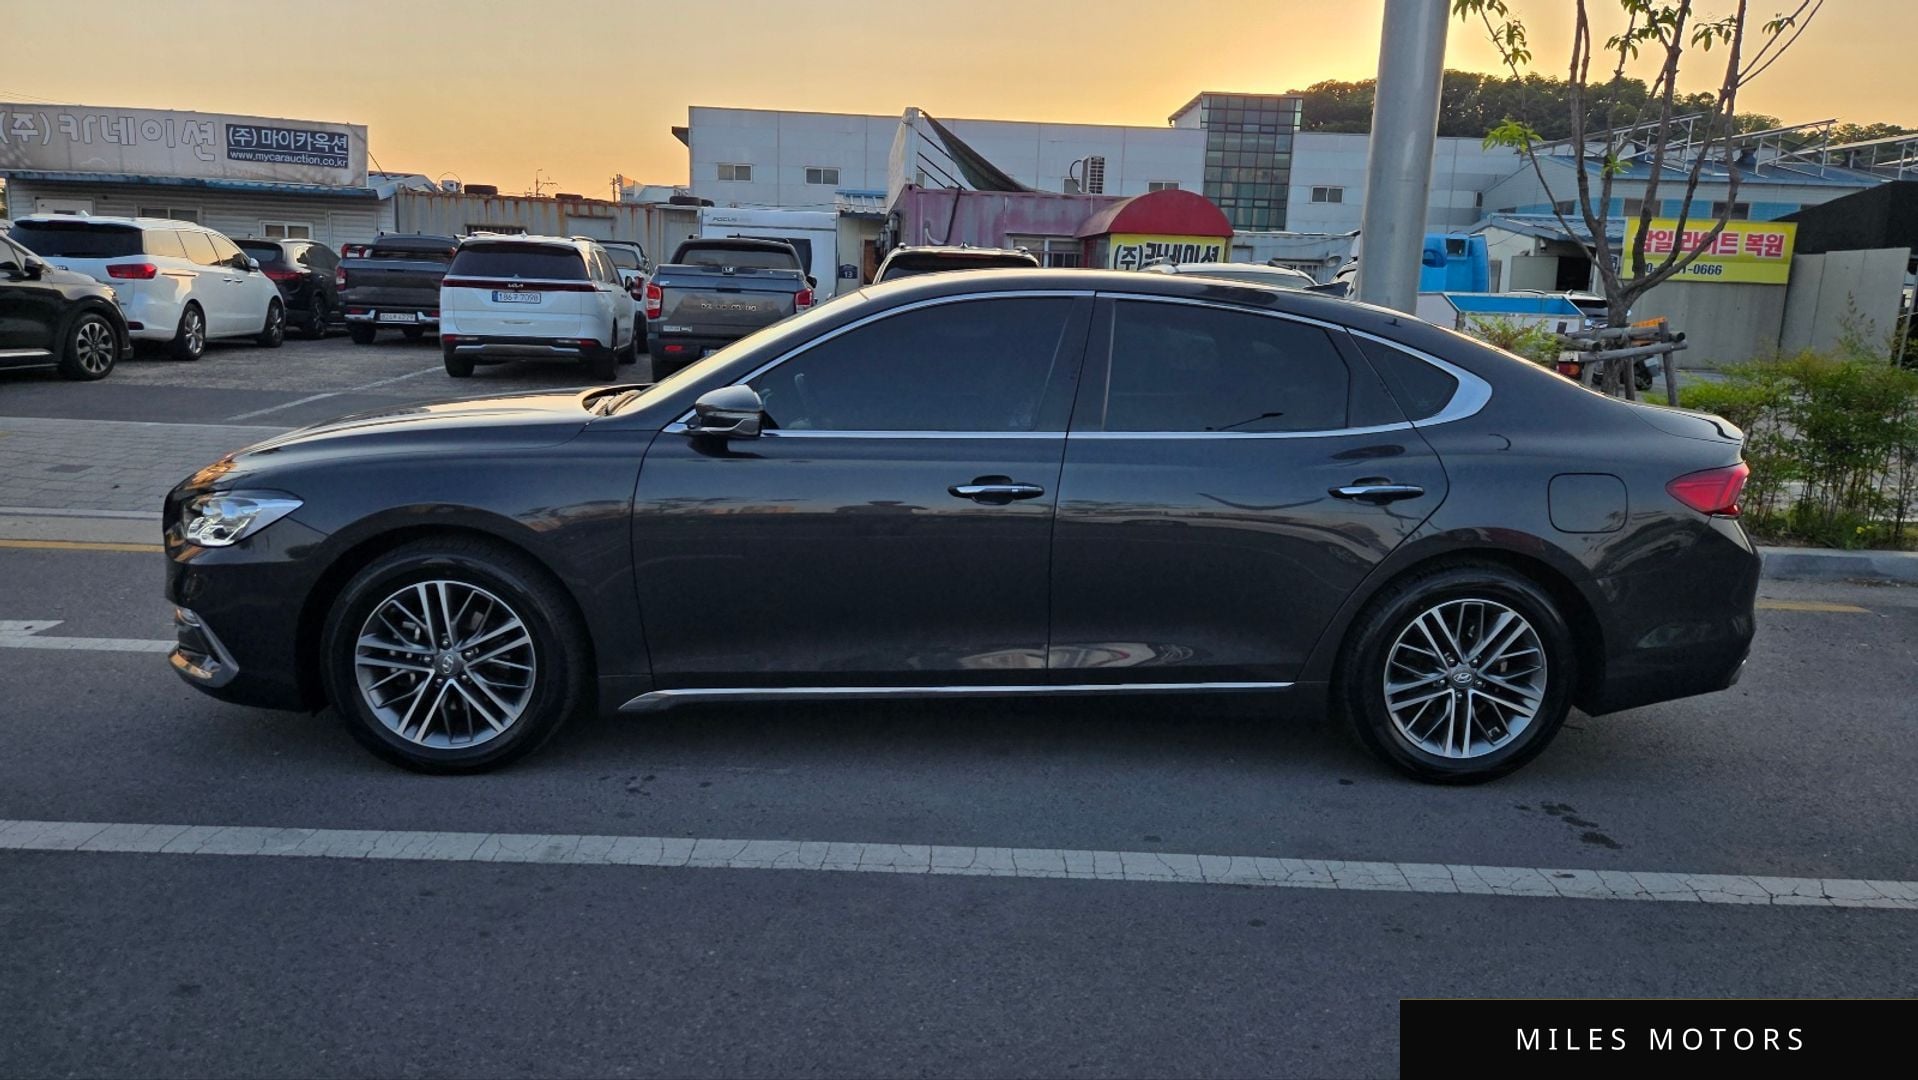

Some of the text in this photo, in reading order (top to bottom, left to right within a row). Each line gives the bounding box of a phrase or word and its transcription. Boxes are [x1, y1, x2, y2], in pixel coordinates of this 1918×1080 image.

[261, 128, 348, 154] 마이카옥션
[230, 150, 347, 168] www.mycarauction.co.kr
[1744, 233, 1786, 259] 복원
